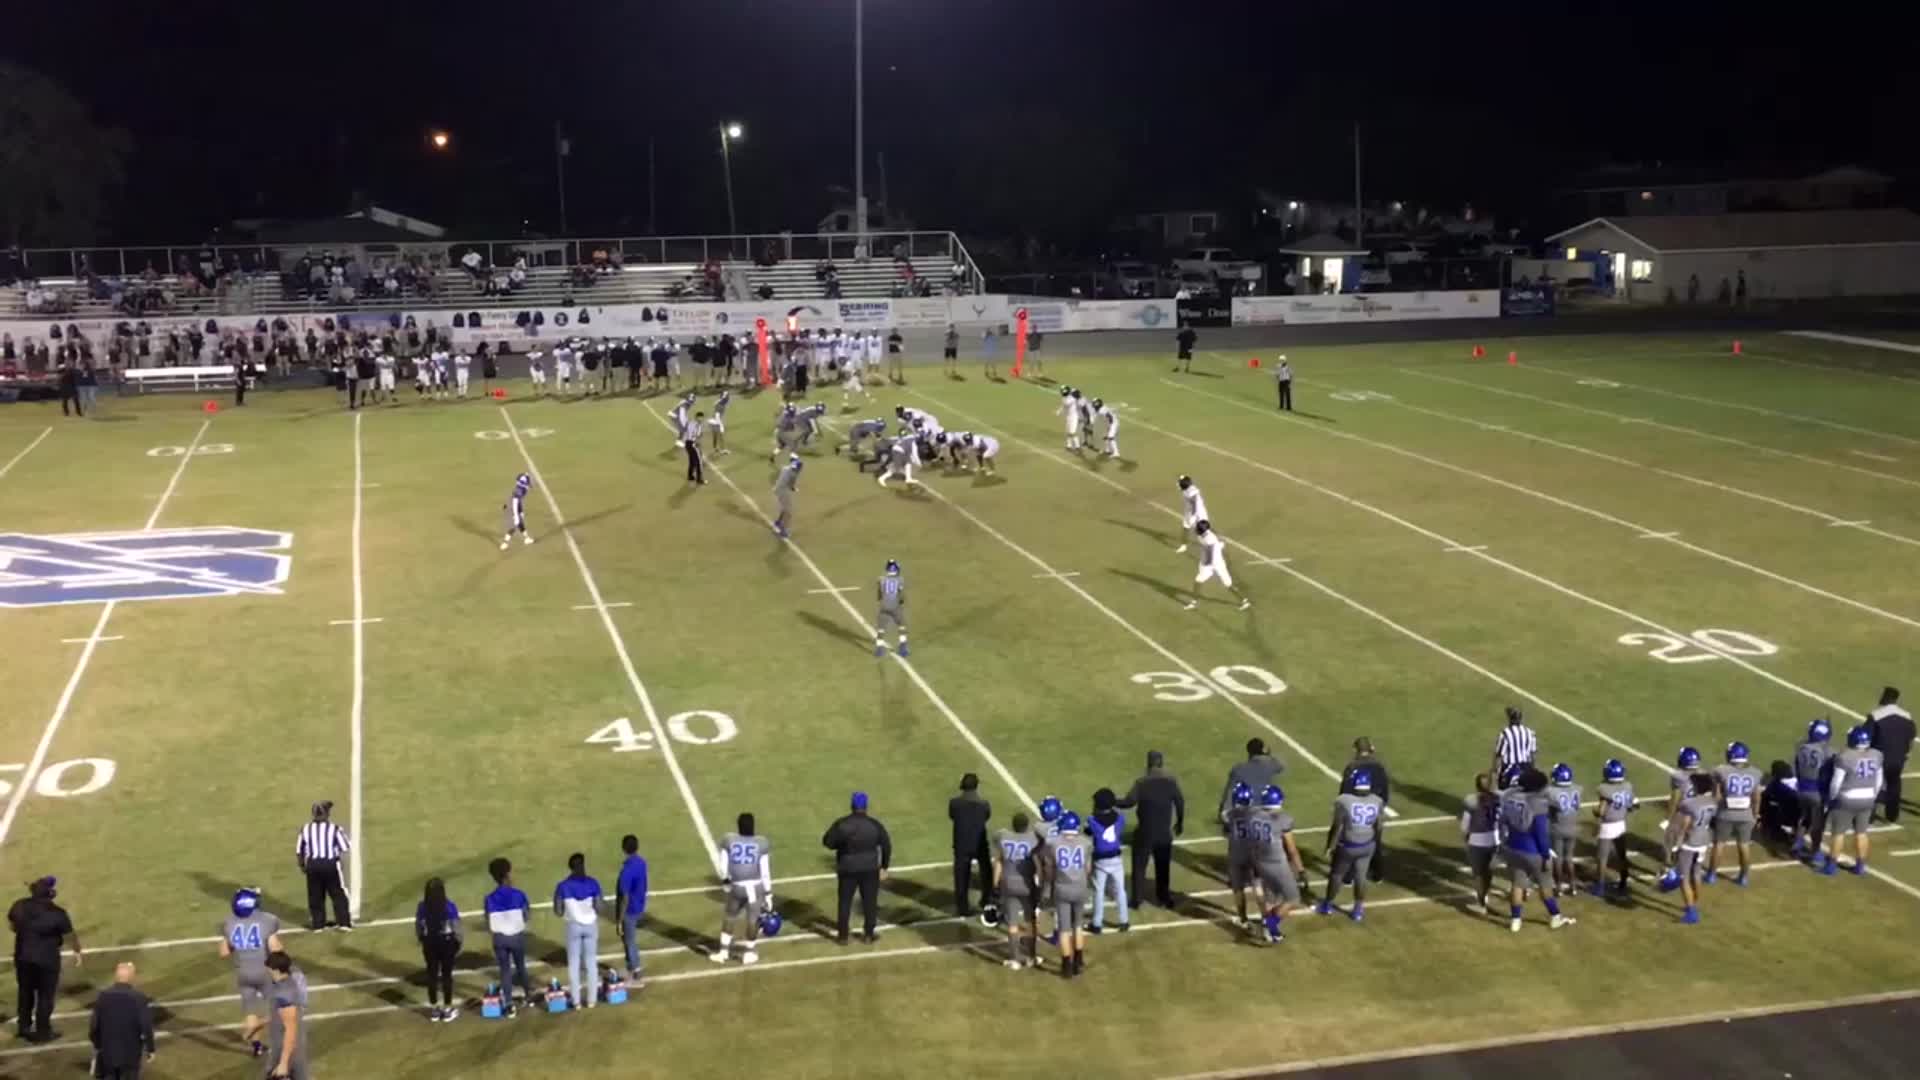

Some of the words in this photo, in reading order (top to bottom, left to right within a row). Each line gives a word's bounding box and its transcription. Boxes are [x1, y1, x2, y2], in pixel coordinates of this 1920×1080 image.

[1617, 628, 1779, 663] 20
[1131, 665, 1288, 703] 30
[584, 709, 738, 753] 40
[1351, 803, 1378, 826] 52
[1101, 825, 1118, 844] 4
[730, 842, 761, 865] 25
[1056, 846, 1084, 870] 64
[230, 922, 262, 950] 44
